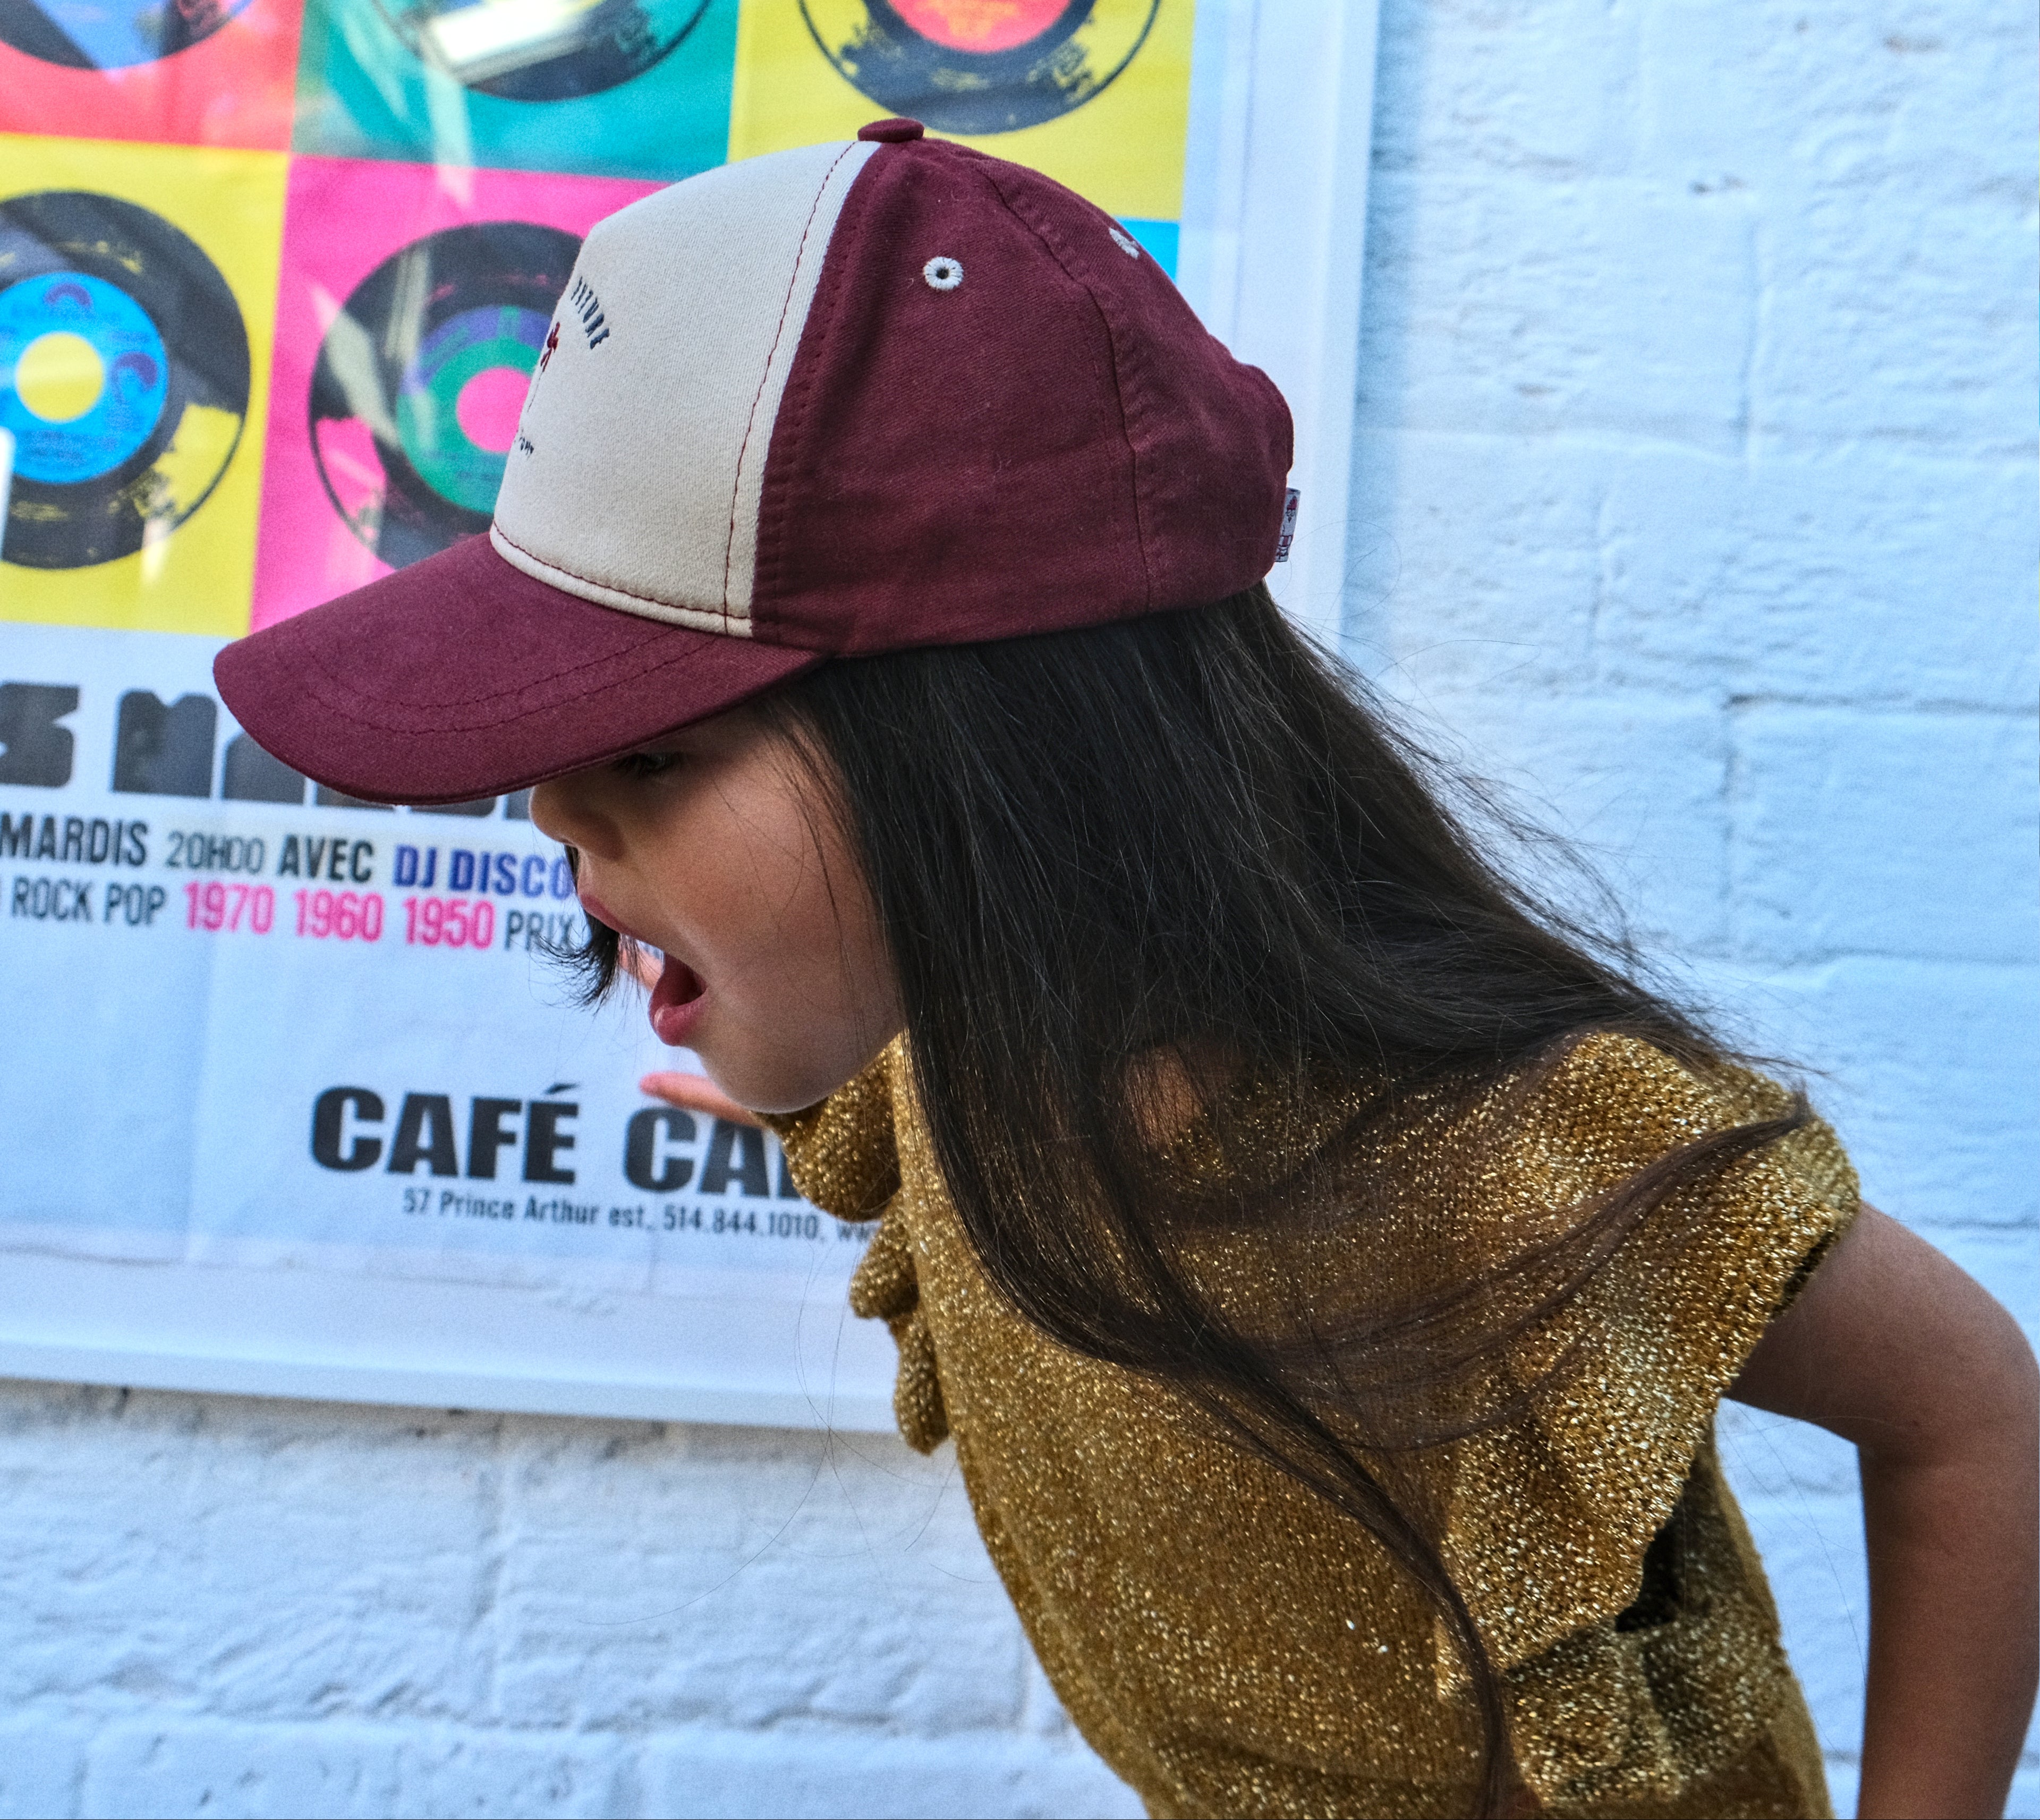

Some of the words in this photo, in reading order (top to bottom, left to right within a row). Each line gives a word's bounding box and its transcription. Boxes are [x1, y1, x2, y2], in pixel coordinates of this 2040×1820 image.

[0, 812, 148, 868] MARDIS
[166, 830, 265, 874] 20H00
[277, 834, 373, 883] AVEC
[393, 845, 437, 889] DJ
[447, 849, 573, 900] DISCO
[12, 875, 94, 922] ROCK
[105, 882, 167, 926] POP
[184, 880, 275, 934] 1970
[293, 889, 385, 943] 1960
[403, 896, 496, 950] 1950
[504, 909, 576, 951] PRIX
[309, 1083, 580, 1190] CAFÉ
[623, 1106, 801, 1200] CA
[403, 1186, 431, 1214] 57
[439, 1189, 514, 1219] Prince
[524, 1194, 599, 1224] Arthur
